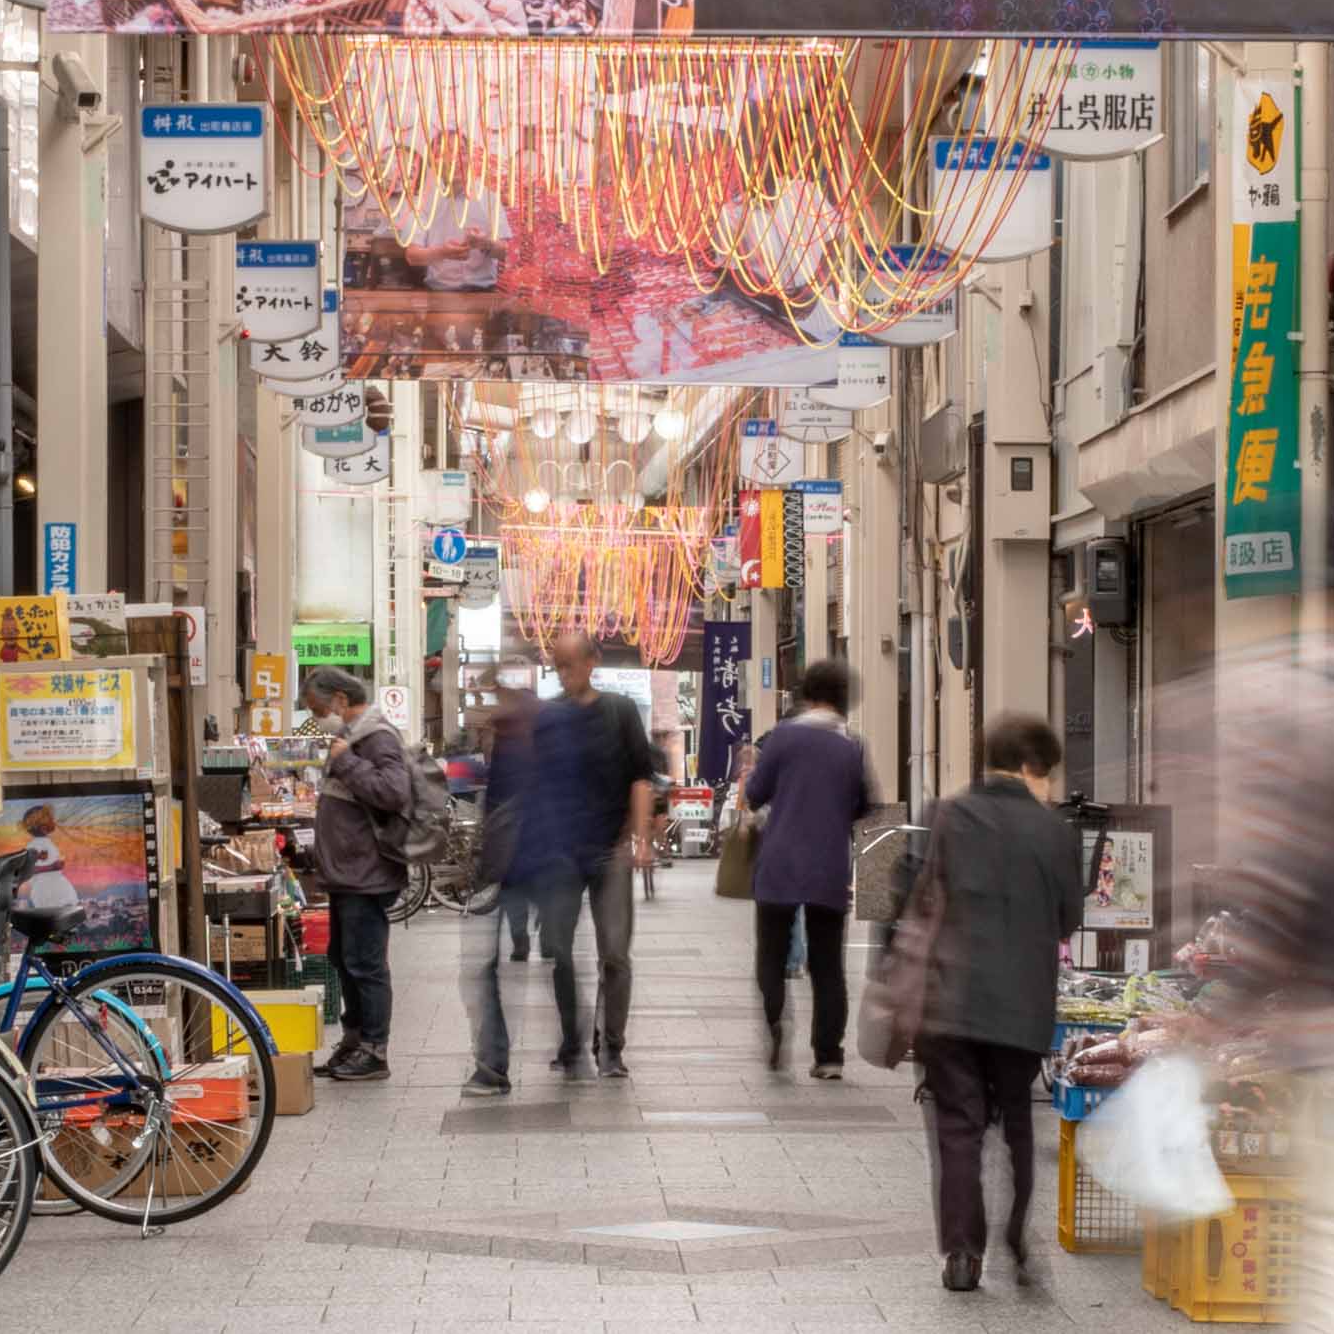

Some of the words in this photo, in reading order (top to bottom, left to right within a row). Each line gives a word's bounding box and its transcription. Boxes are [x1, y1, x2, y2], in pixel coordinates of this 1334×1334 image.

[1026, 93, 1155, 131] 井上呉服店
[199, 121, 253, 133] 出町商店街
[185, 171, 258, 191] アイハート
[255, 296, 313, 310] アイハート
[1234, 255, 1278, 506] 宅急便
[294, 643, 359, 658] 自動販売機
